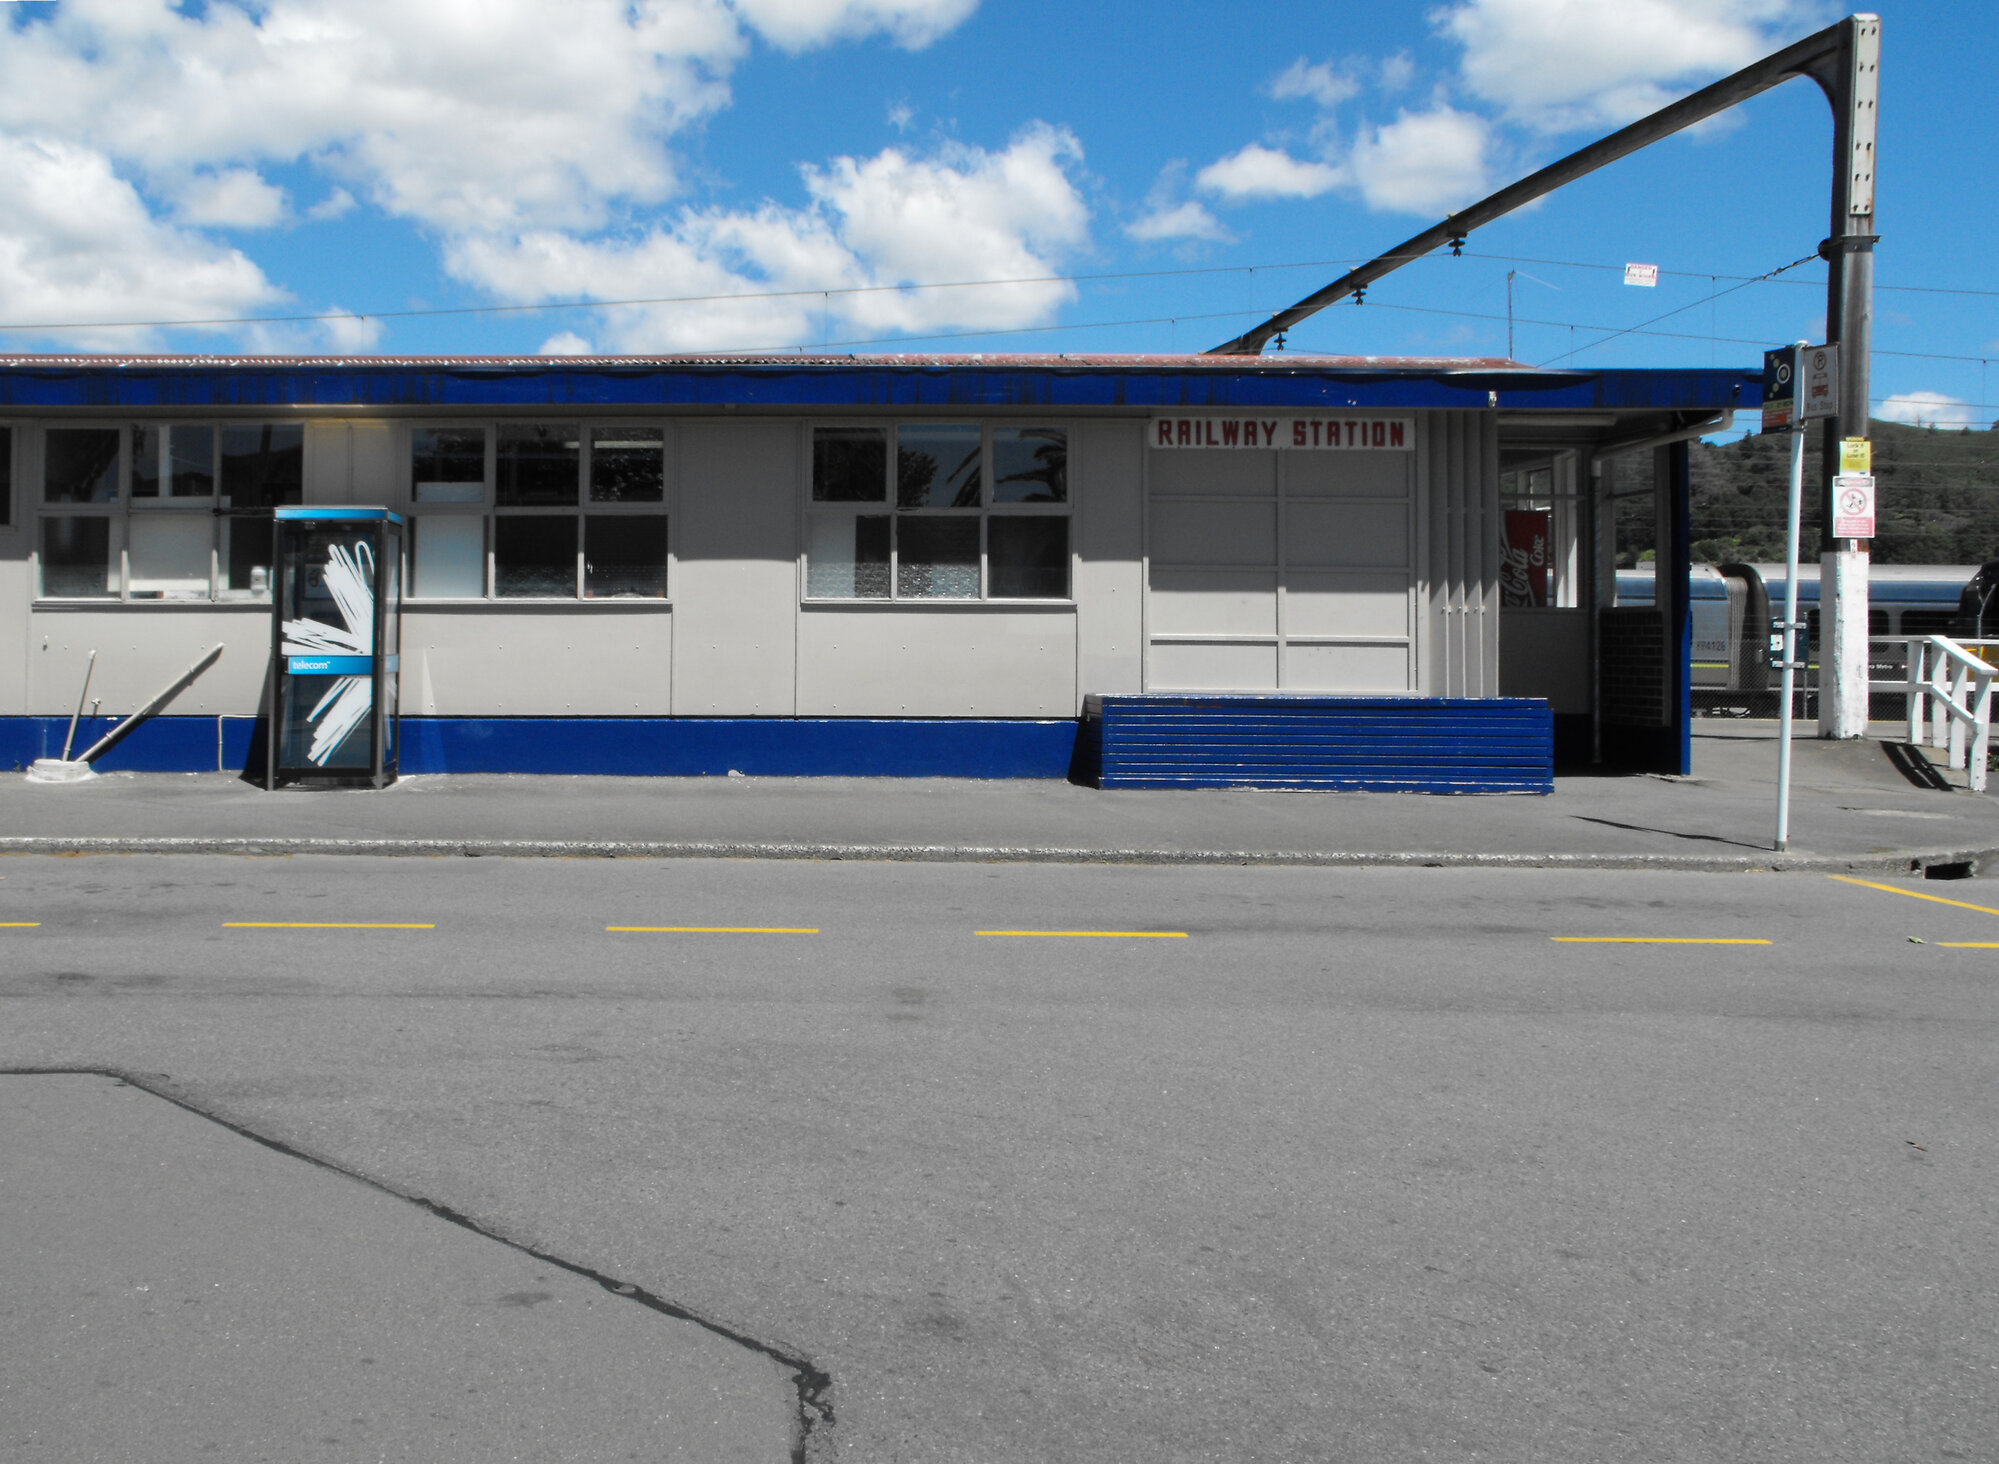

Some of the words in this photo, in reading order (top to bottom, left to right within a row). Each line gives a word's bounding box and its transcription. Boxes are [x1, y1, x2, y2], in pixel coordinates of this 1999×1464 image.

[1158, 420, 1277, 446] RAILWAY
[1293, 420, 1404, 447] STATION
[1529, 534, 1545, 567] Coke
[292, 661, 328, 670] telecom
